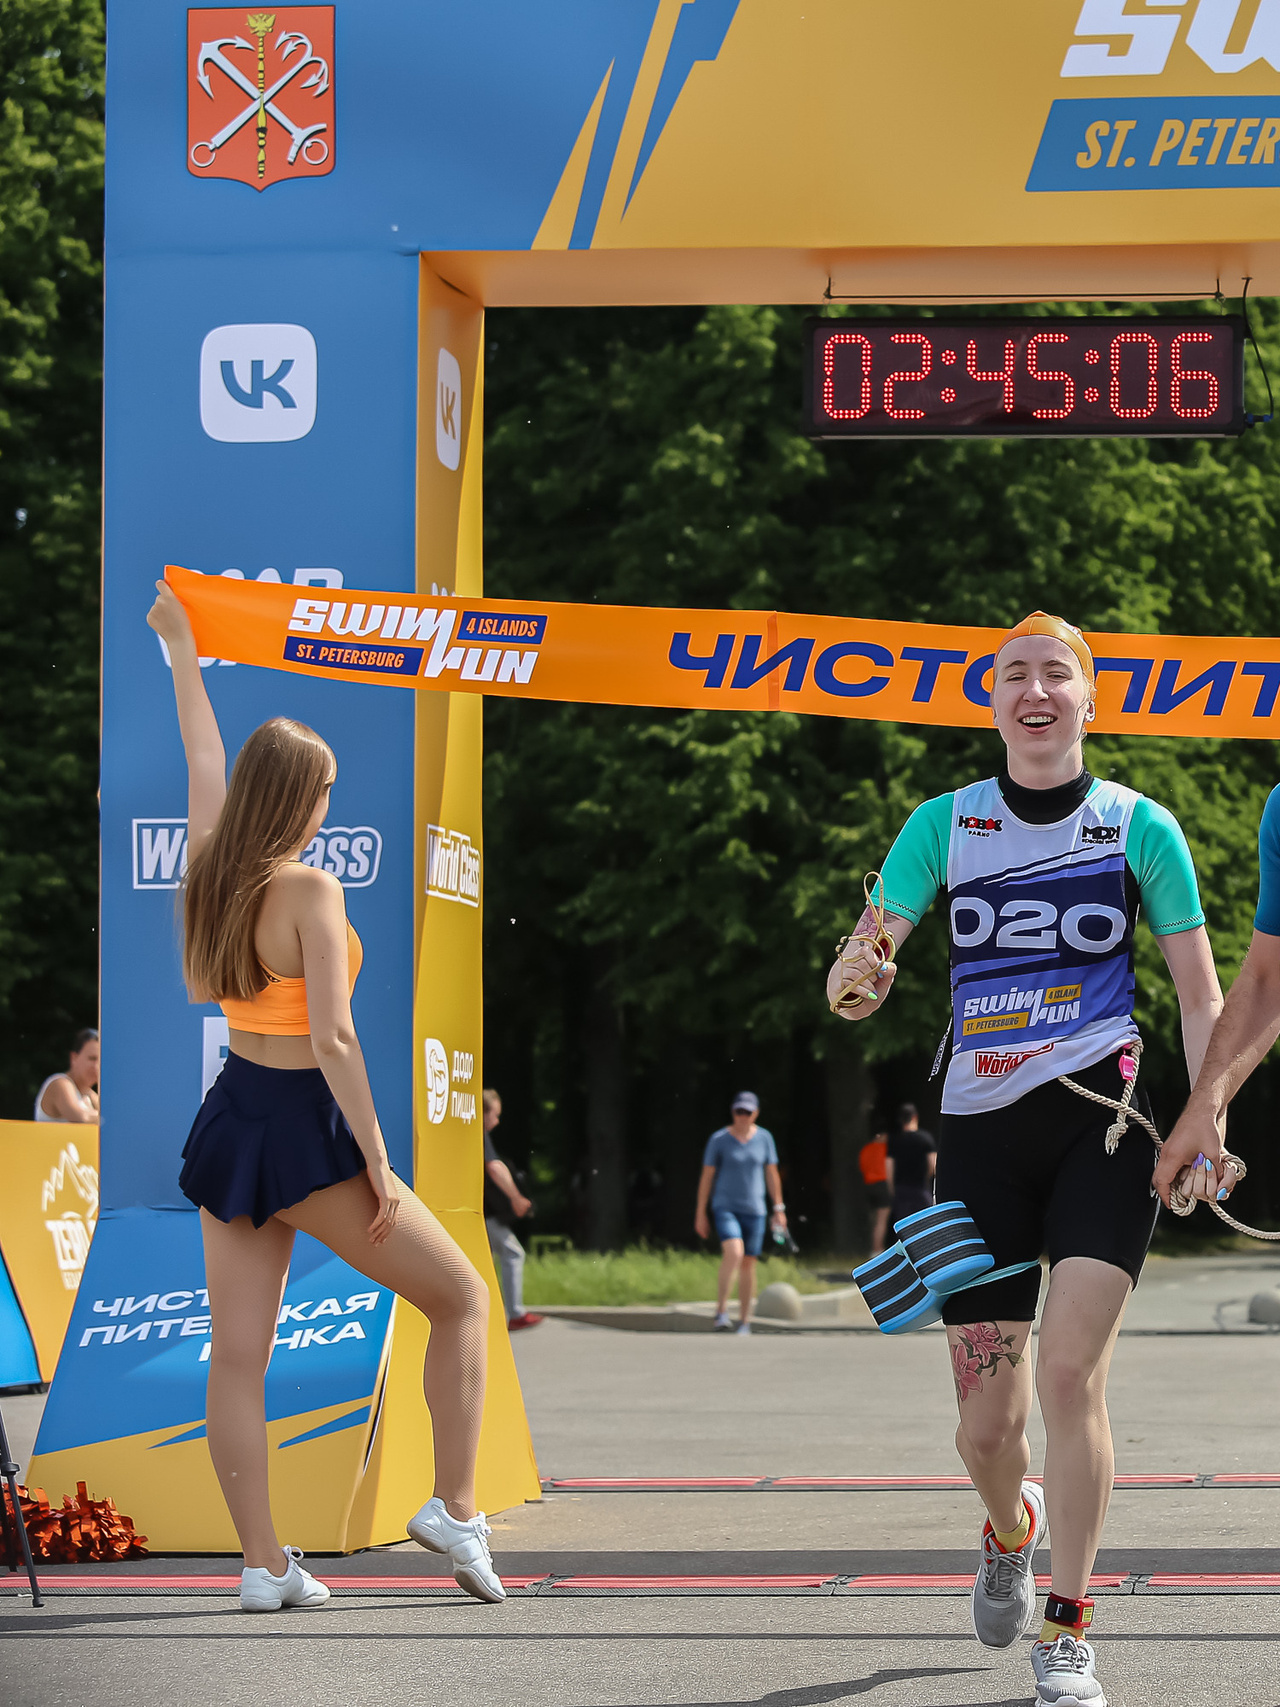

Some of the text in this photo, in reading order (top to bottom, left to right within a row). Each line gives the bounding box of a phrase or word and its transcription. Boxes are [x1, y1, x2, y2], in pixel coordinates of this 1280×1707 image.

[1076, 120, 1137, 169] ST.
[823, 332, 1219, 419] 02:45:06
[466, 618, 539, 638] 4 ISLANDS
[296, 643, 405, 669] ST. PETERSBURG
[951, 897, 1128, 954] 020
[975, 1016, 1020, 1031] PETERSBURG
